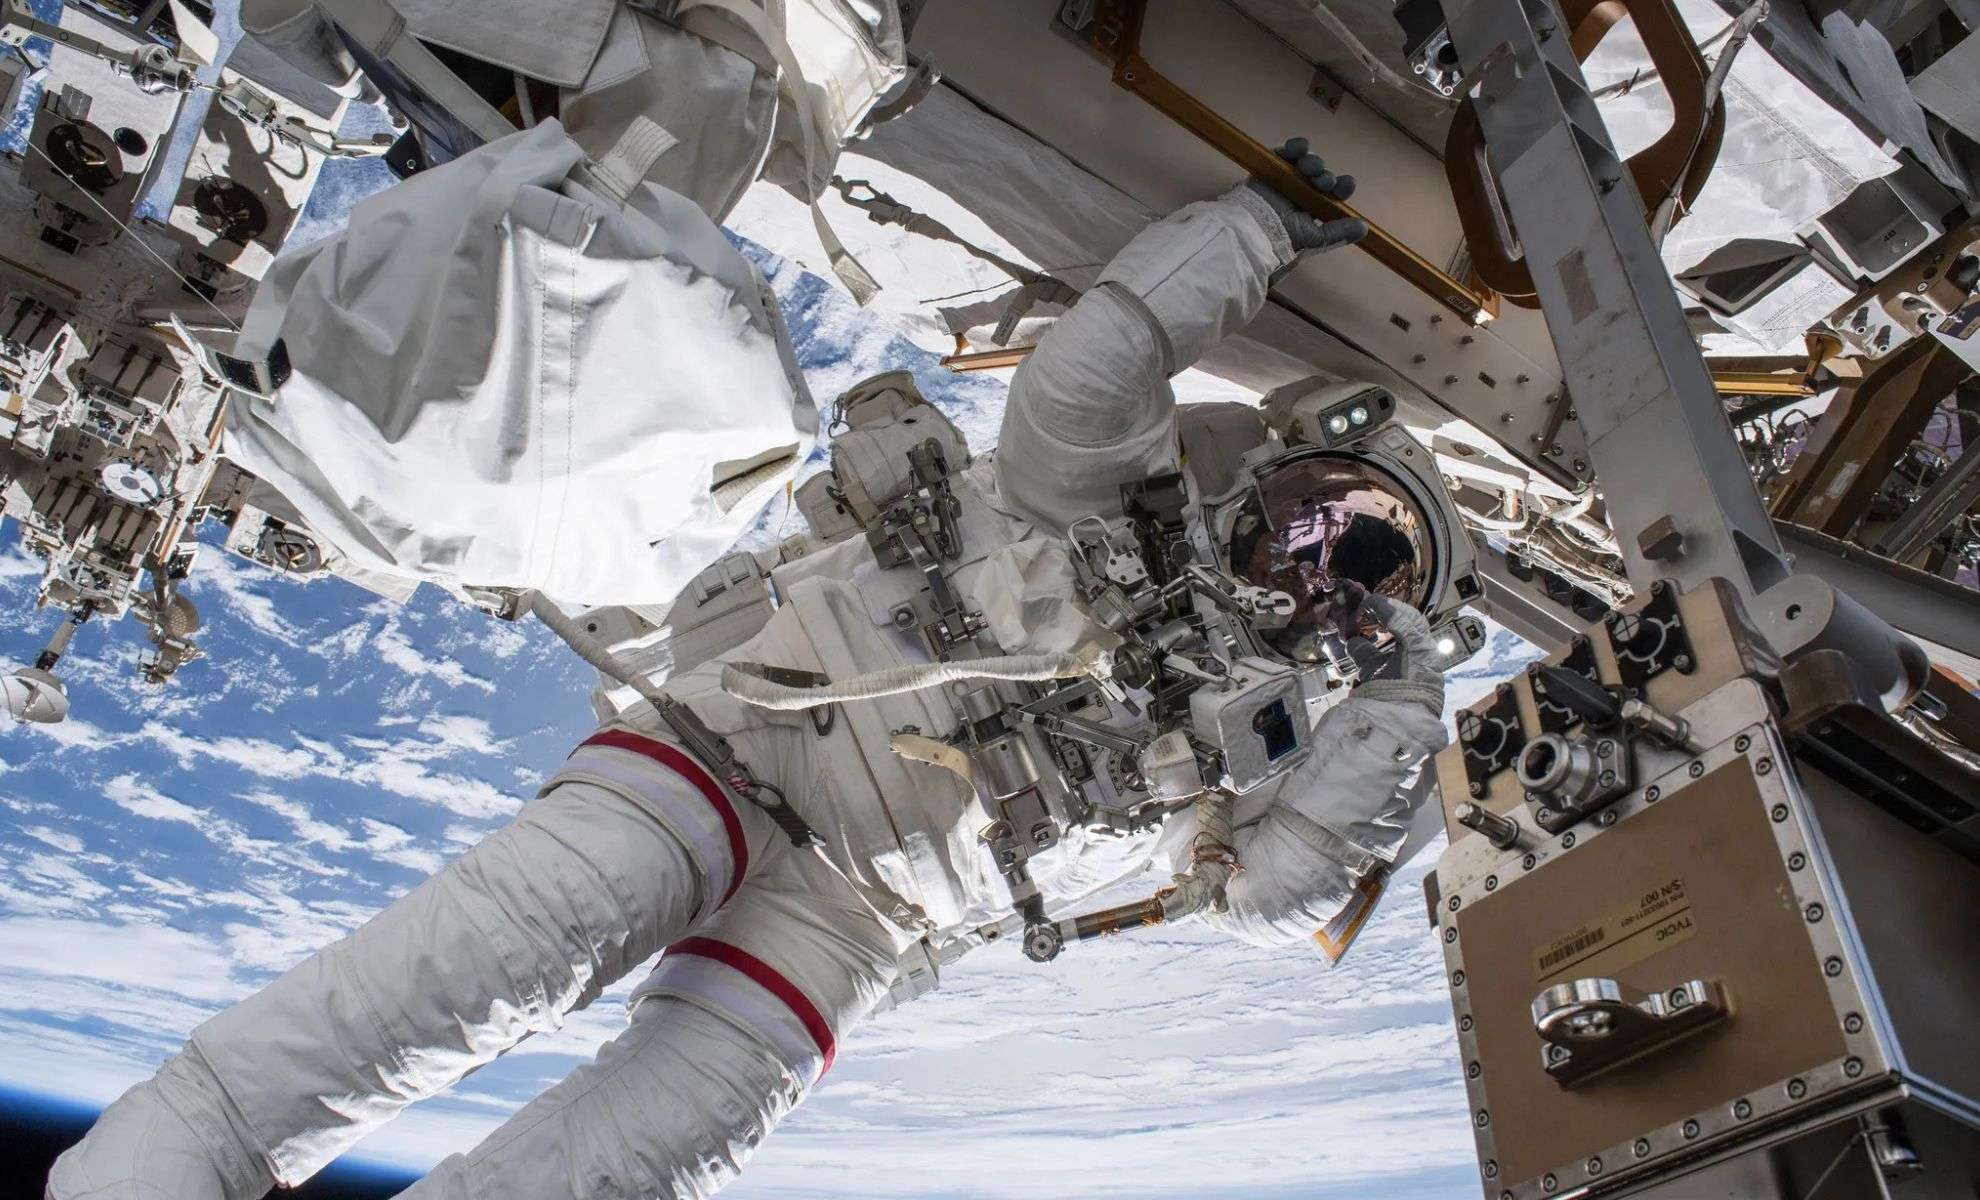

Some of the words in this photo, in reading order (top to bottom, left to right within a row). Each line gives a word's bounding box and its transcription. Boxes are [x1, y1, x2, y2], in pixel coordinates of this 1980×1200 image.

[1660, 879, 1682, 898] S/N
[1640, 892, 1660, 908] 007
[1655, 917, 1694, 942] TVCIC
